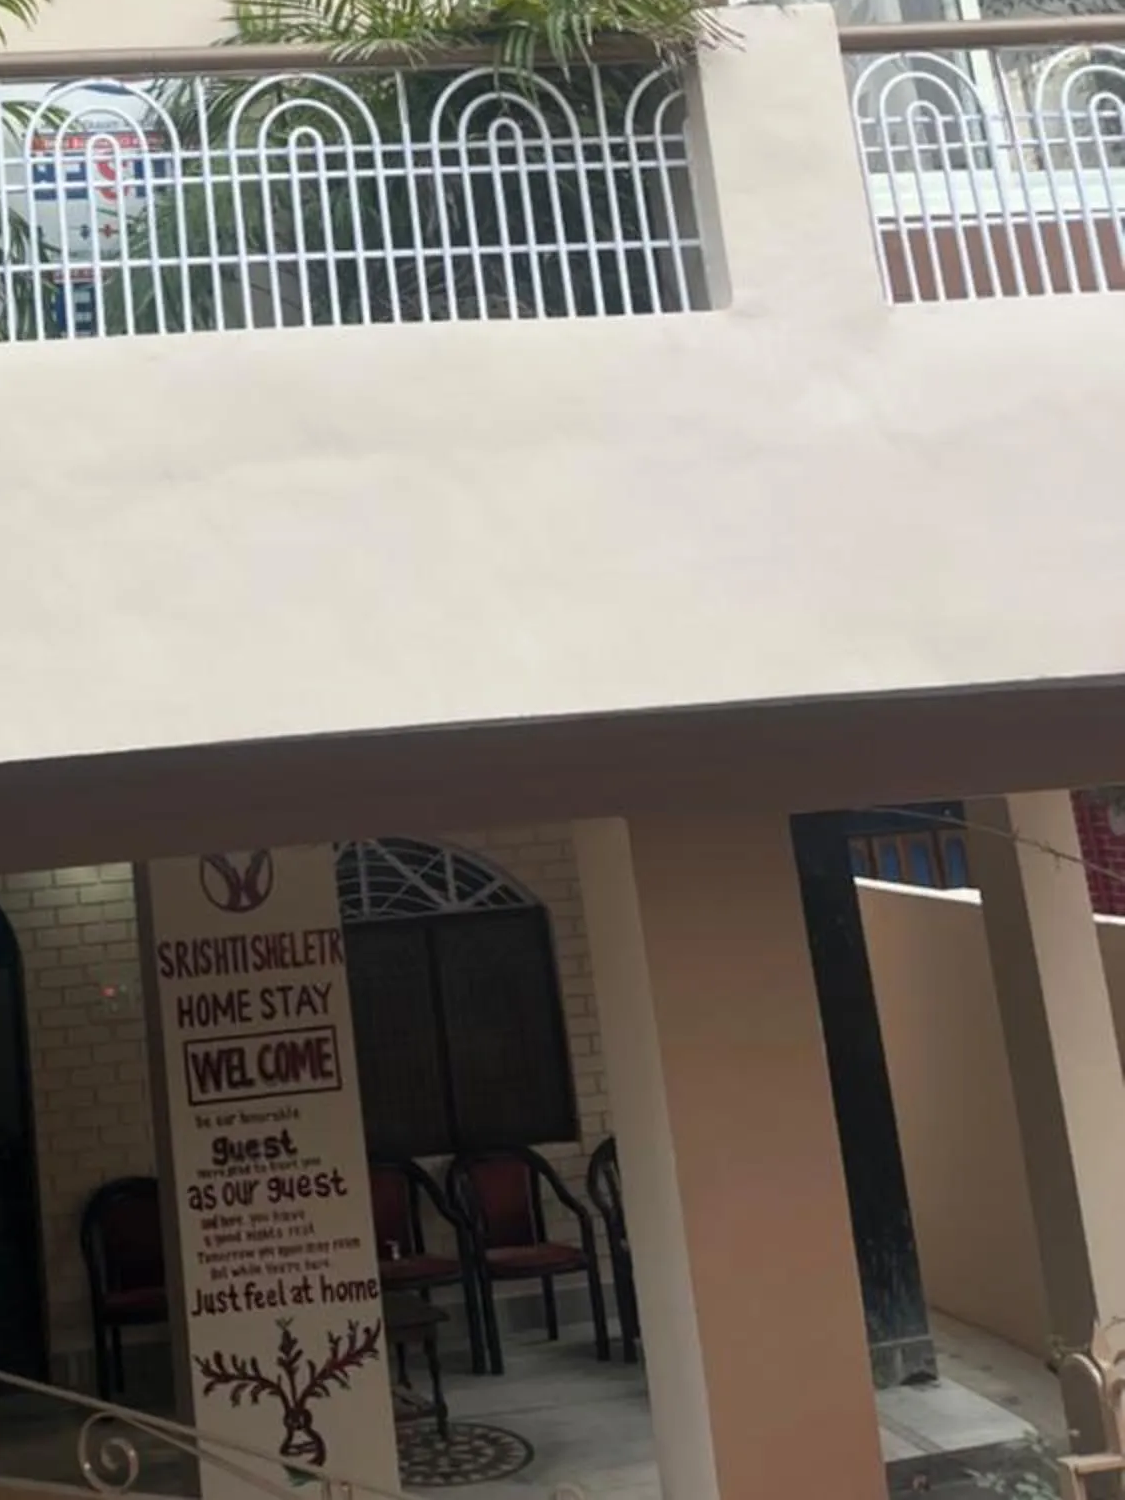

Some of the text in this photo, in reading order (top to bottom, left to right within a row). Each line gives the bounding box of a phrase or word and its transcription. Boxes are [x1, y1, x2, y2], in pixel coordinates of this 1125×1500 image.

[157, 933, 250, 980] SRISHTI
[177, 982, 333, 1028] HOME STAY
[211, 1128, 298, 1166] guest
[187, 1167, 348, 1211] as our guest
[191, 1274, 380, 1317] Just feel at home
